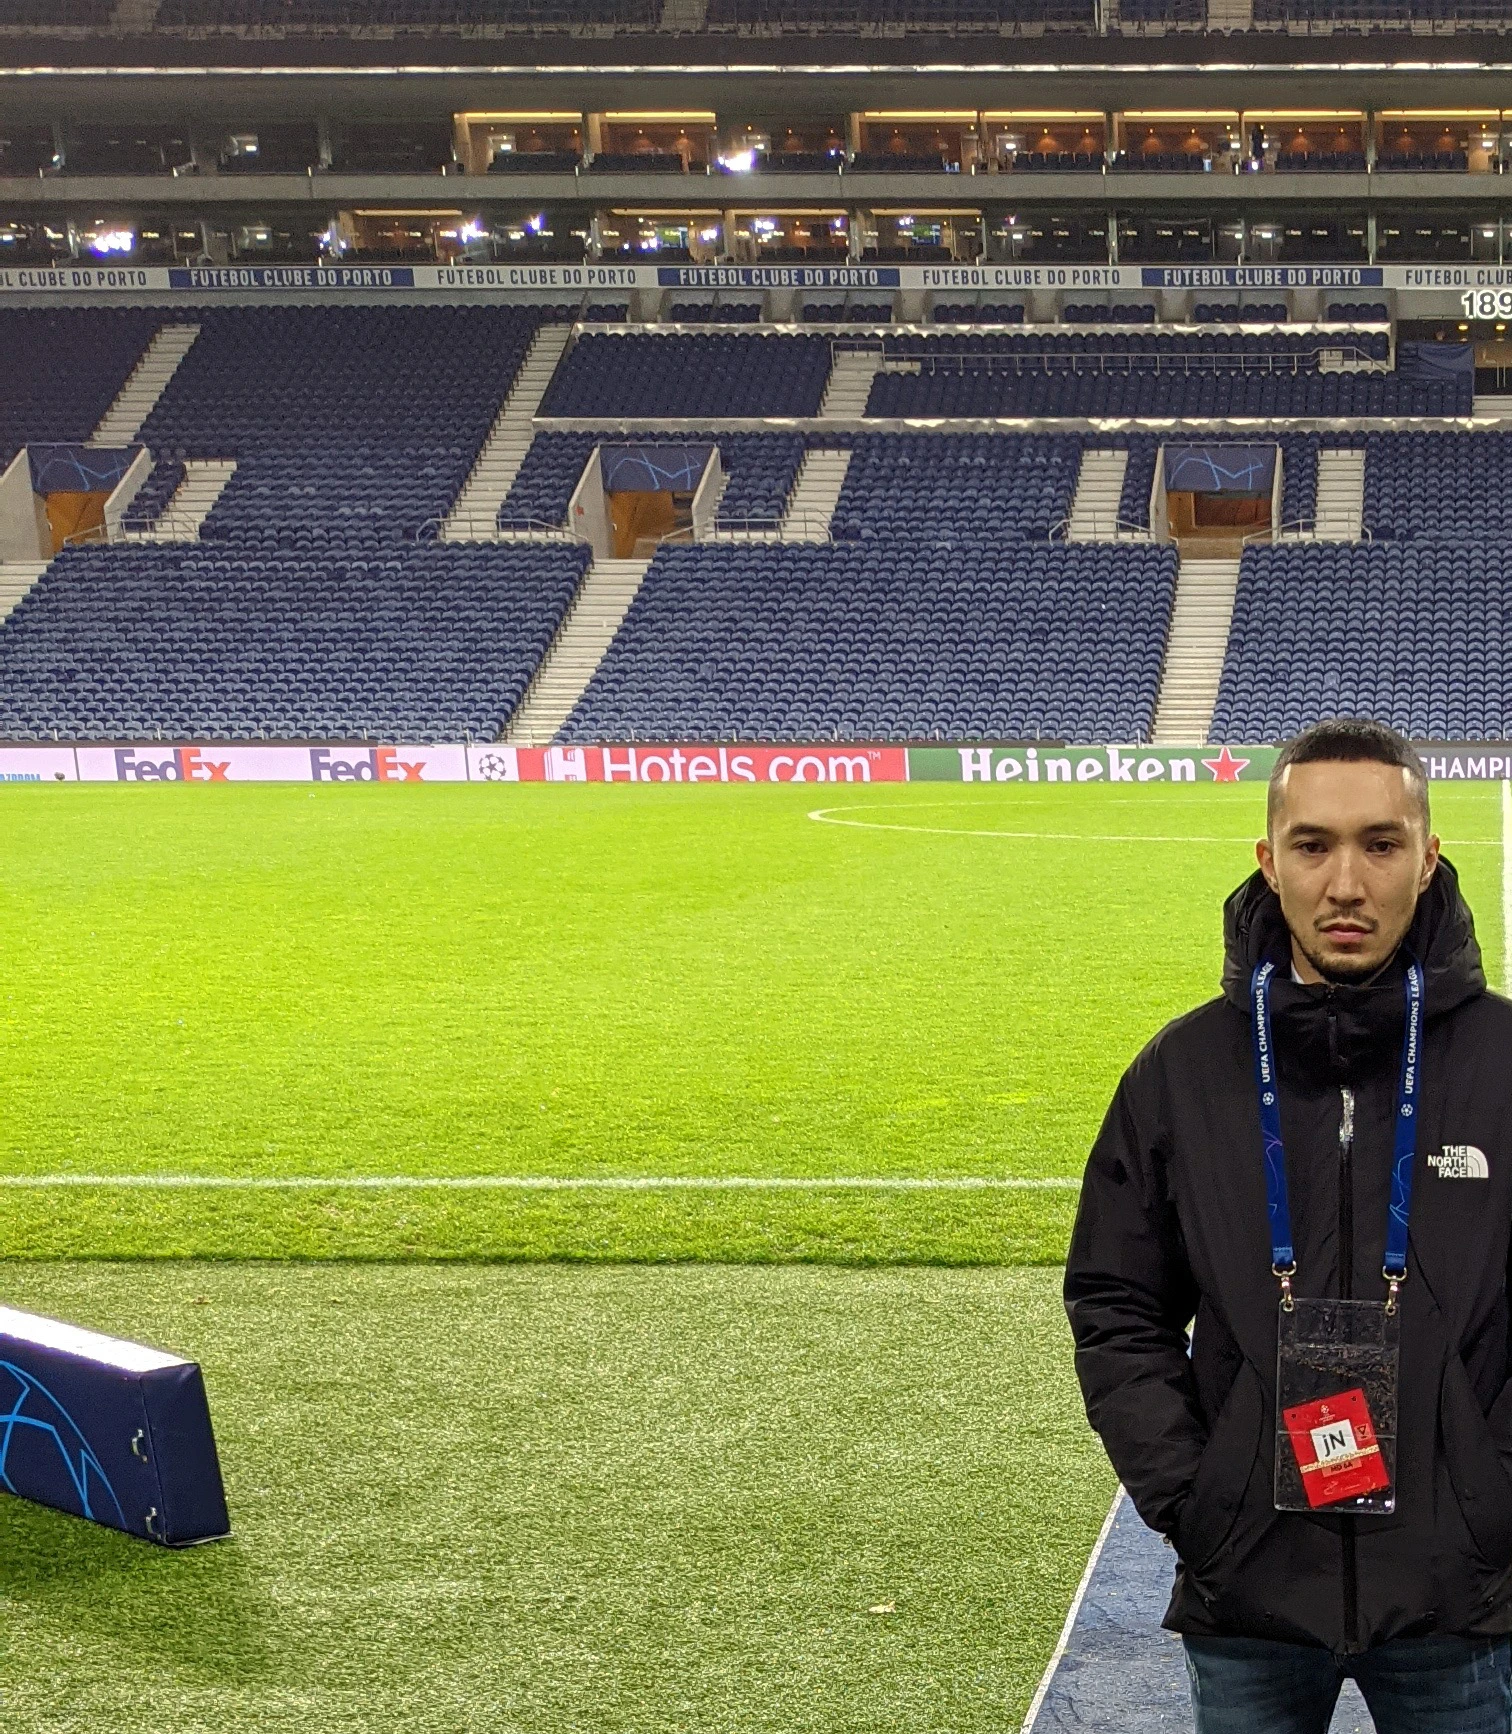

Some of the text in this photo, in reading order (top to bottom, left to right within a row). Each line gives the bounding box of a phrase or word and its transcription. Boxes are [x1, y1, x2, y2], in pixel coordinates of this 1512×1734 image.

[19, 268, 66, 287] CLUBE
[72, 268, 92, 287] DO
[97, 268, 147, 287] PORTO
[191, 269, 392, 286] FUTEBOL CLUBE DO PORTO
[437, 269, 637, 285] FUTEBOL CLUBE DO PORTO
[679, 269, 878, 286] FUTEBOL CLUBE DO PORTO
[923, 269, 1120, 285] FUTEBOL CLUBE DO PORTO
[1163, 269, 1361, 285] FUTEBOL CLUBE DO PORTO
[1405, 269, 1471, 285] FUTEBOL
[114, 748, 232, 781] FedEx
[309, 748, 427, 781] FedEx
[602, 747, 871, 782] Hotelscom
[958, 747, 1197, 782] Heineken
[1255, 988, 1268, 1053] CHAMPIONS
[1407, 1001, 1420, 1064] CHAMPIONS
[1261, 1053, 1271, 1083] UEFA
[1405, 1066, 1415, 1094] UEFA
[1442, 1145, 1467, 1157] THE
[1427, 1156, 1467, 1168] NORTH
[1438, 1167, 1467, 1178] FACE
